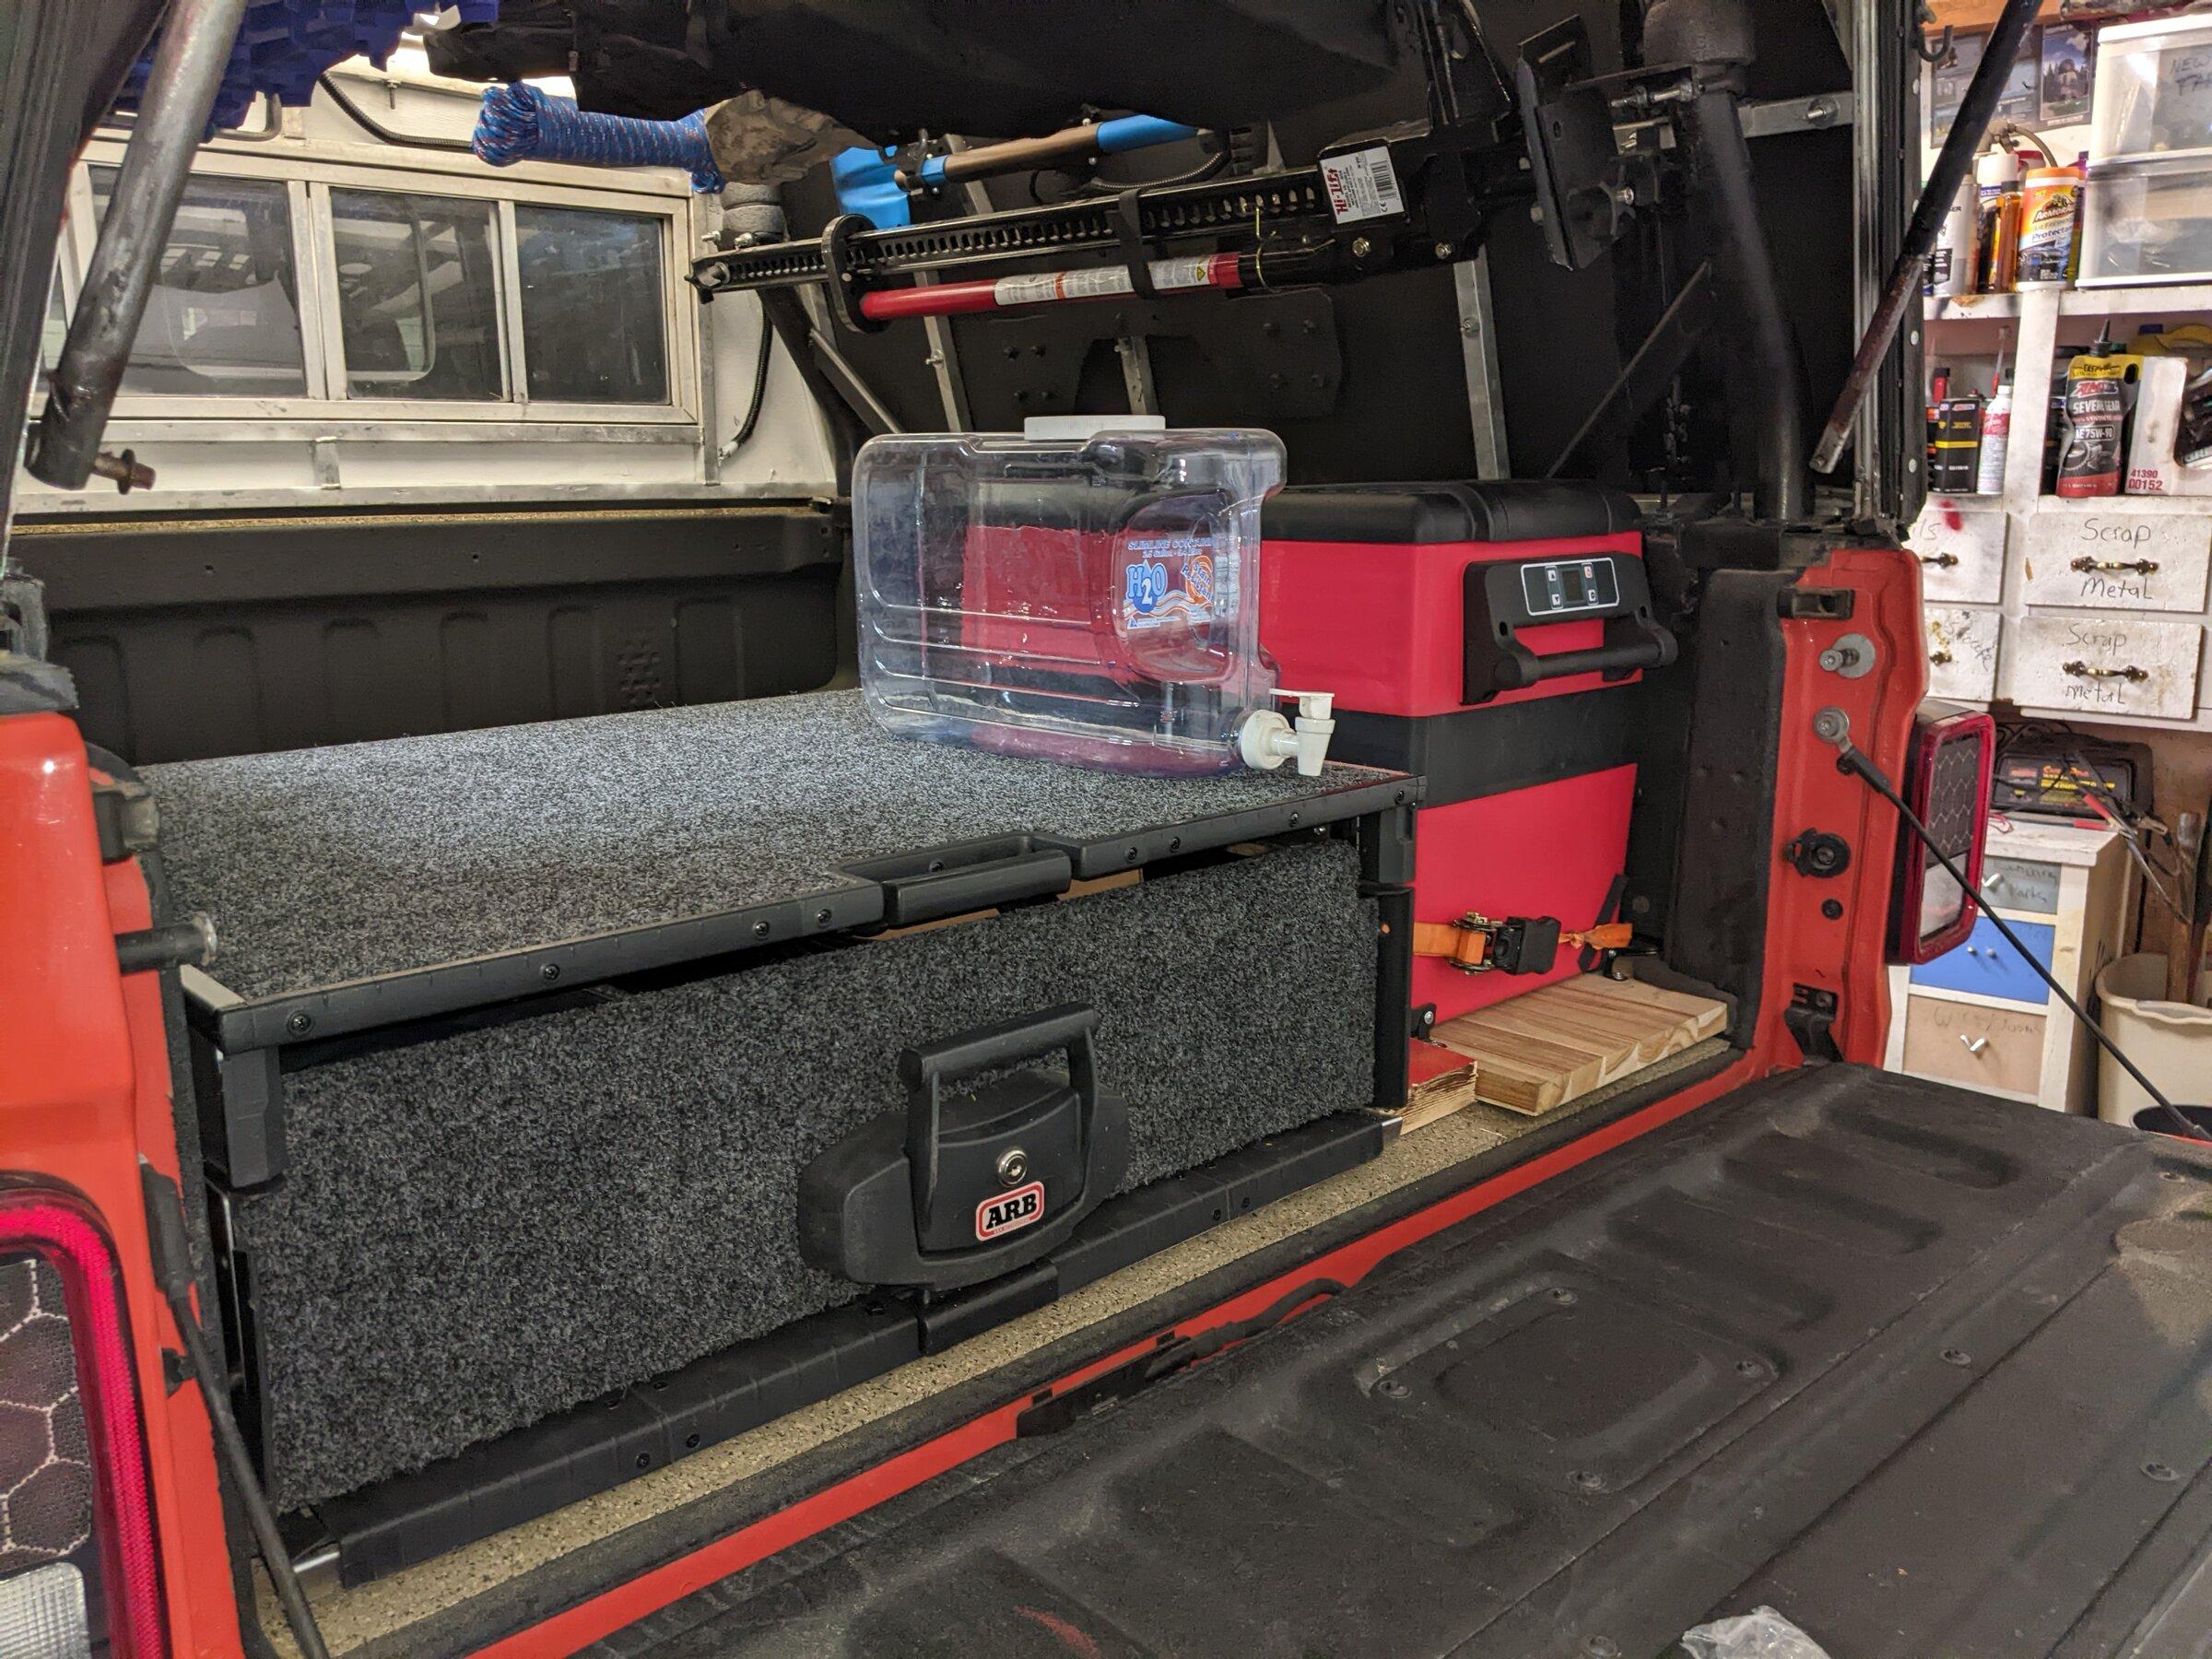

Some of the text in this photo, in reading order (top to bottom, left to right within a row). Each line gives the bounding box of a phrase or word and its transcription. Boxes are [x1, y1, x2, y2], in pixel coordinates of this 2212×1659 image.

[2128, 479, 2163, 490] 00152
[2130, 469, 2159, 478] 41390
[2082, 518, 2151, 548] Scrap
[1127, 563, 1168, 606] H2O
[1194, 563, 1211, 587] Stain
[2066, 623, 2127, 655] Scrap
[985, 1193, 1037, 1230] ARB
